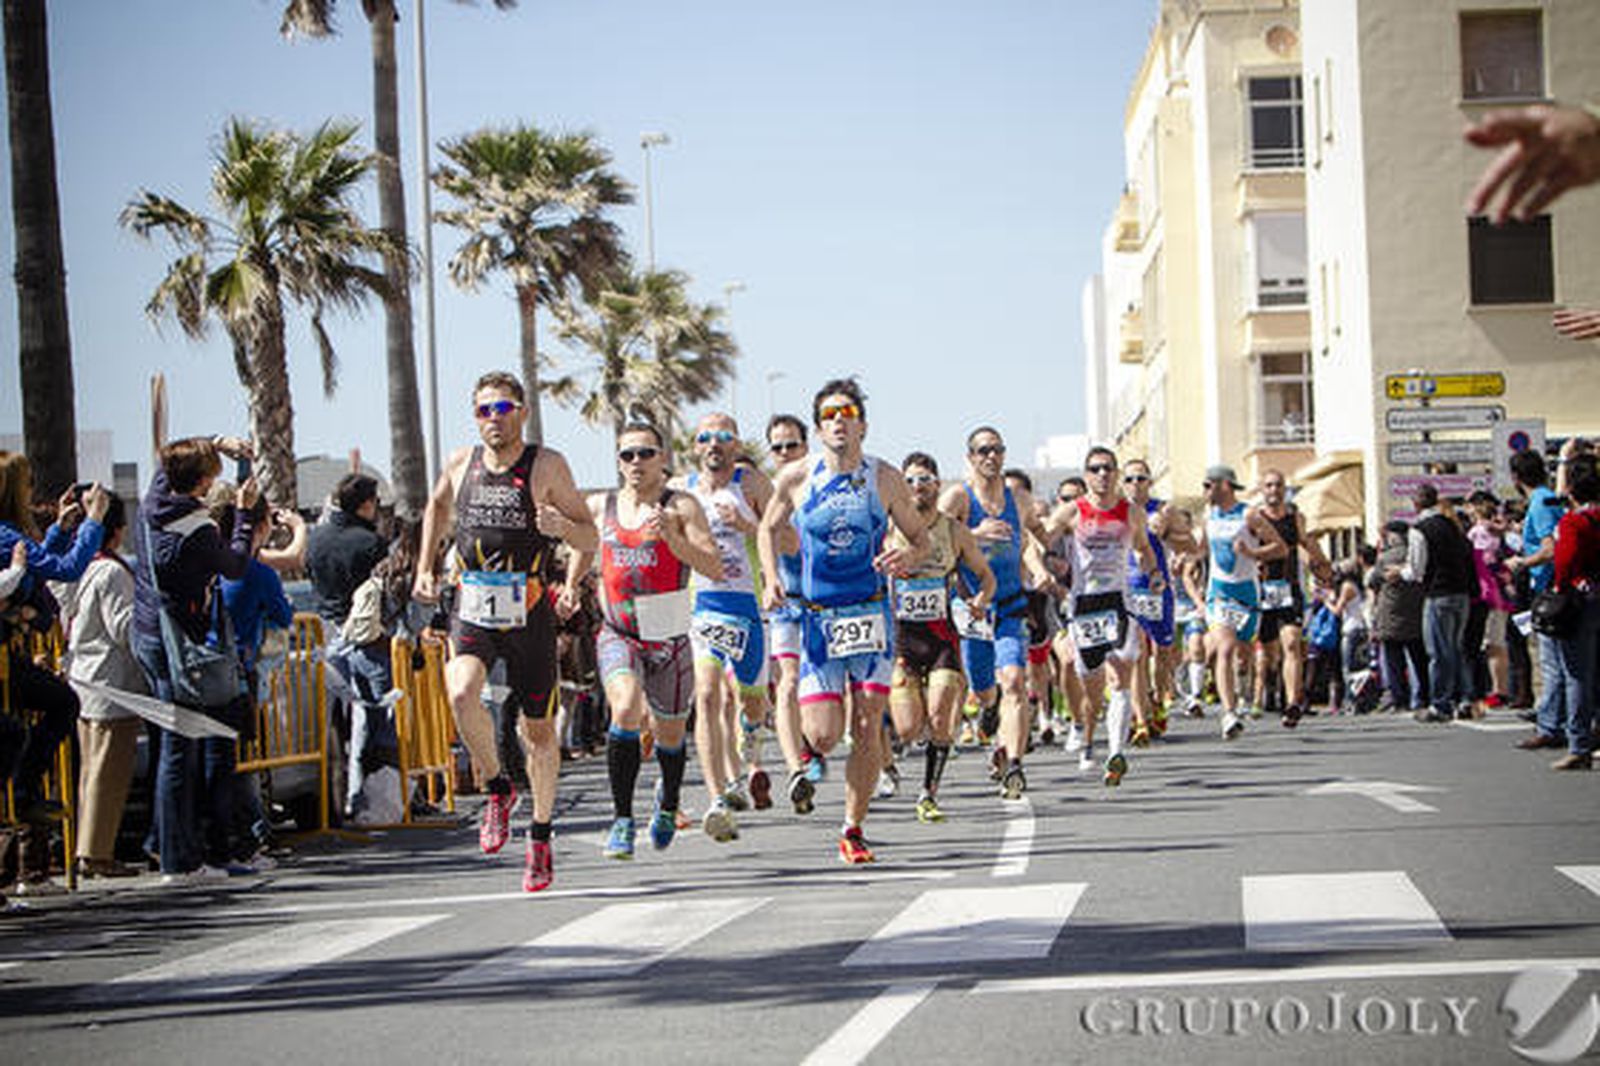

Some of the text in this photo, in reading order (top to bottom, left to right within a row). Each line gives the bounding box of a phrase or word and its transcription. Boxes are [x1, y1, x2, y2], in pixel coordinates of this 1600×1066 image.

[485, 594, 496, 616] 1
[905, 594, 939, 612] 342
[832, 620, 873, 645] 297
